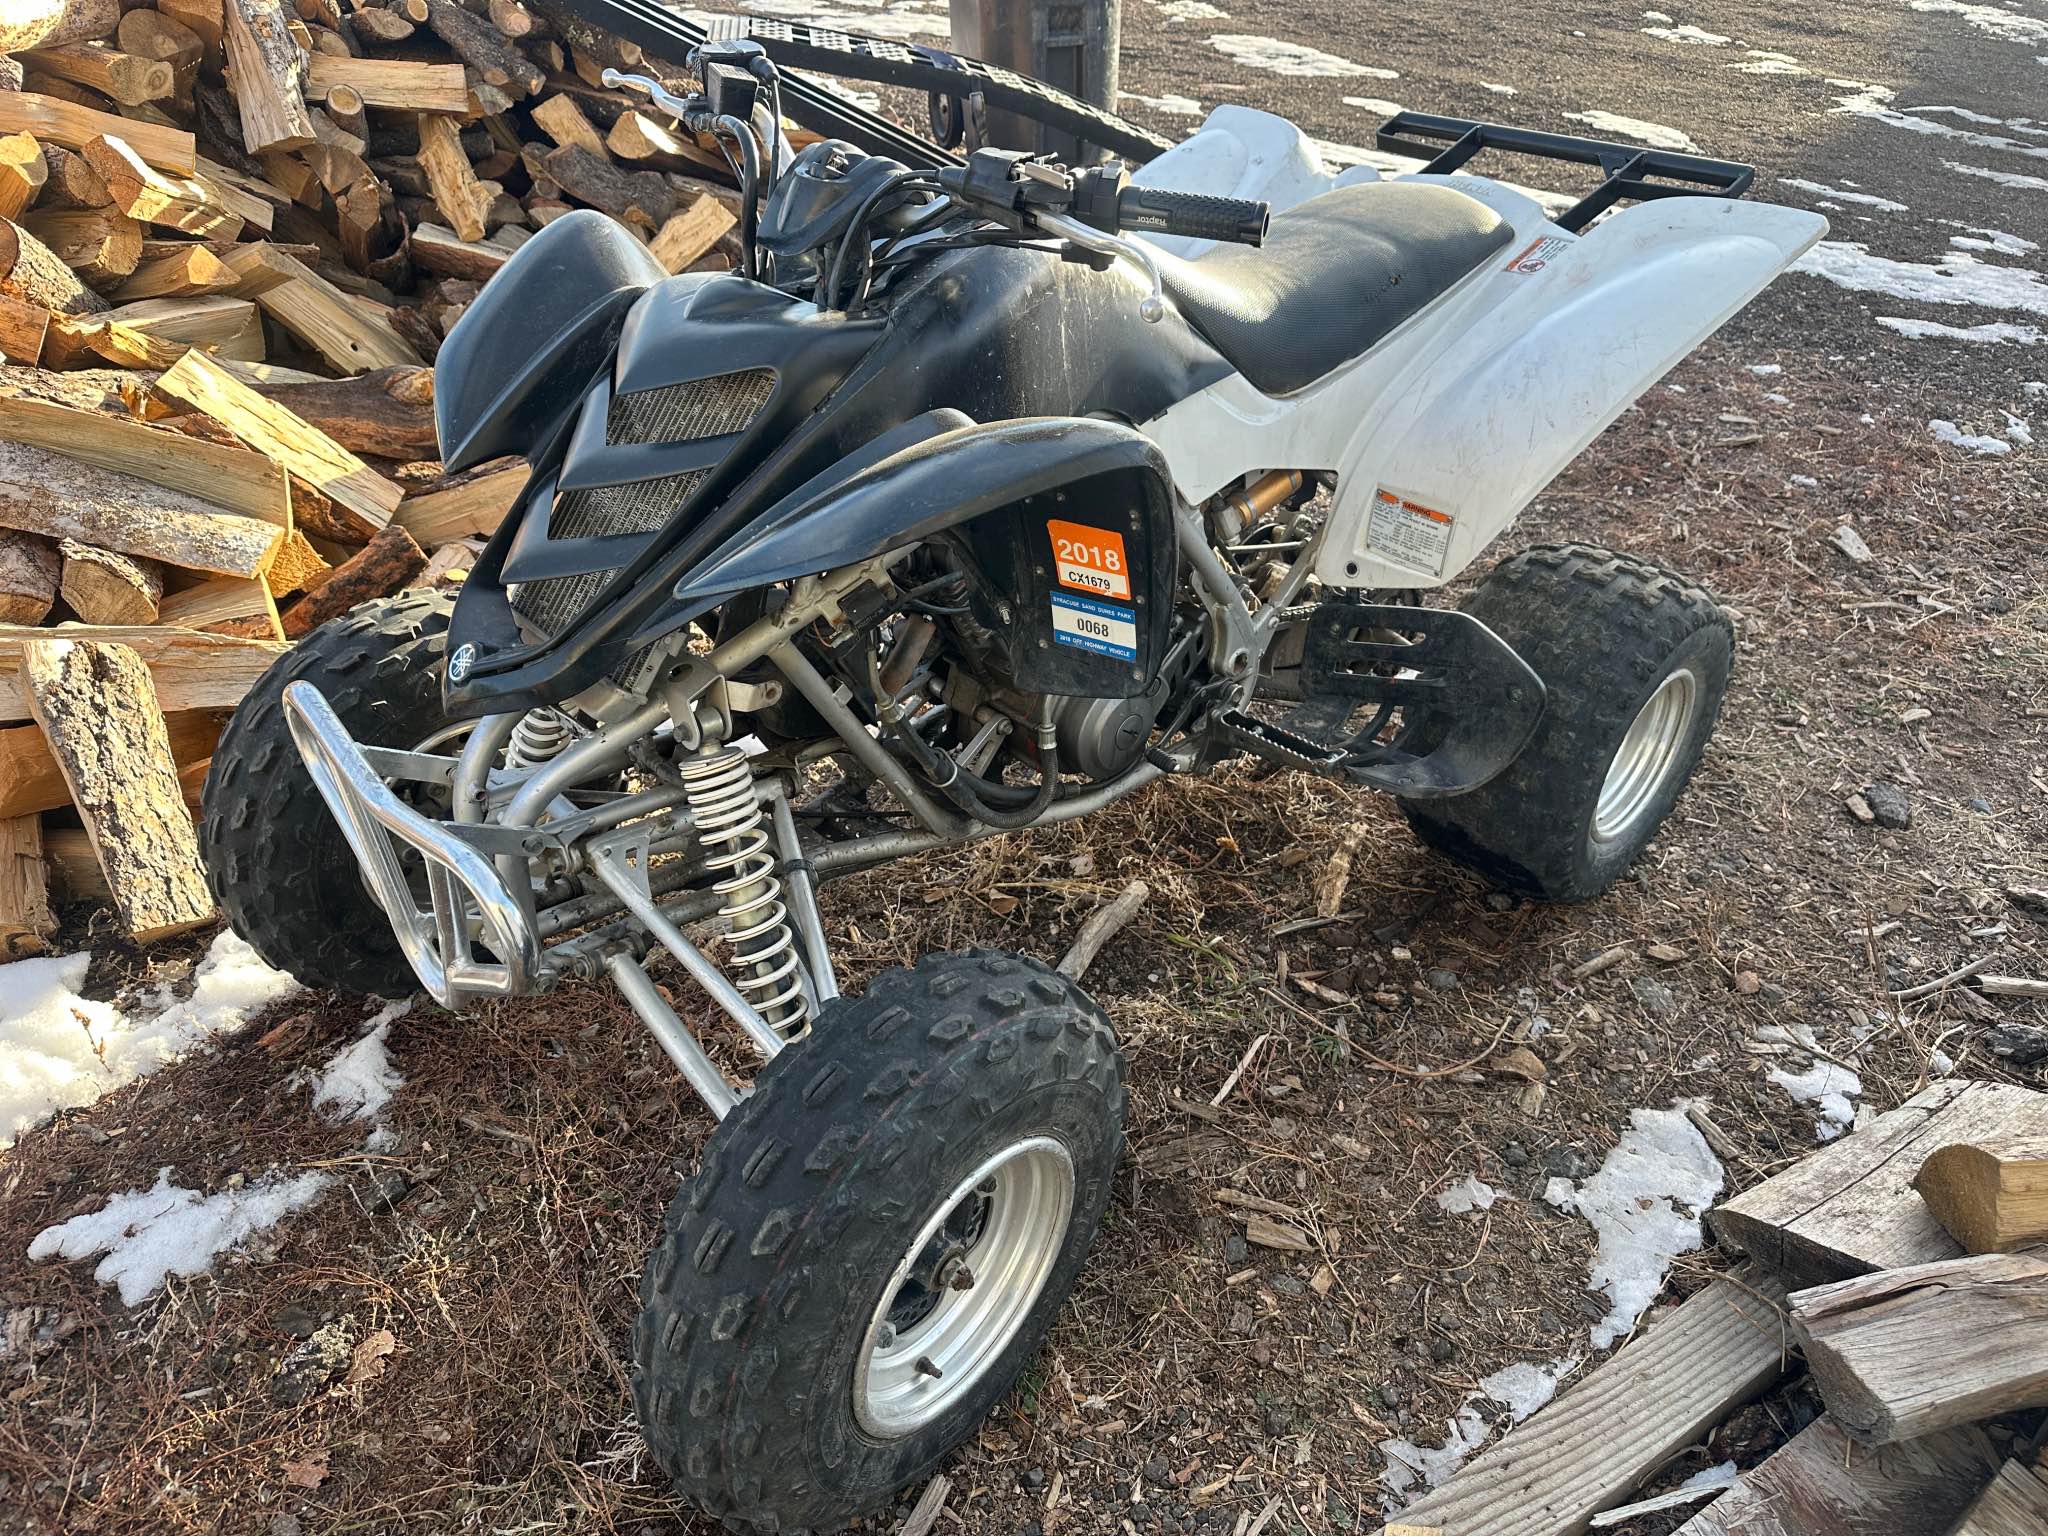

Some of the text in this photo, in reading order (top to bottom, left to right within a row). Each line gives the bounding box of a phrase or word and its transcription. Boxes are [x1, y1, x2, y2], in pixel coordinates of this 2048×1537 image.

[1136, 216, 1168, 228] Raptor
[1402, 501, 1431, 517] WARNING
[1057, 539, 1121, 571] 2018
[1068, 571, 1111, 590] CX1679
[1053, 597, 1132, 620] SYRACUSE SAND DUNES PARK
[1077, 618, 1109, 637] 0068
[1084, 641, 1107, 651] HIGHWAY
[1109, 646, 1131, 658] VEHICLE
